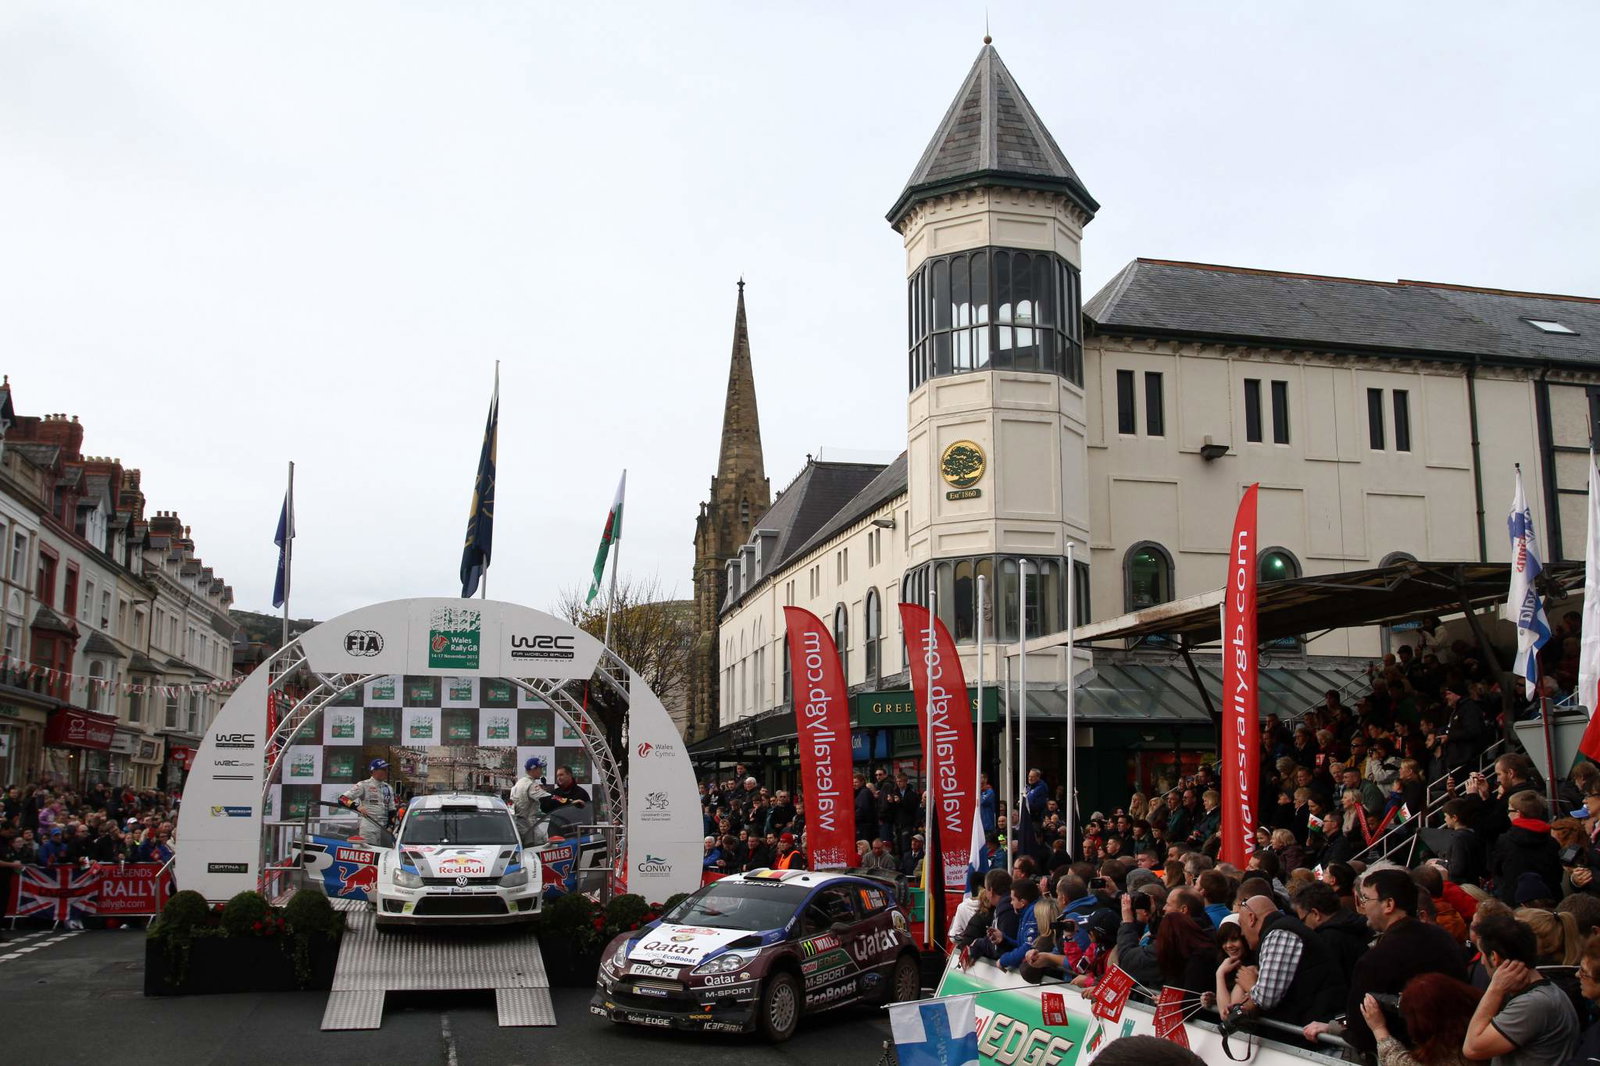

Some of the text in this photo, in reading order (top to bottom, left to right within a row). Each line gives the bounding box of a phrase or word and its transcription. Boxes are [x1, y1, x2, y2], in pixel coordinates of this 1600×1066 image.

[511, 634, 575, 649] WRC
[1232, 530, 1257, 855] walesrallygb.com
[872, 702, 918, 714] GREE
[216, 733, 255, 742] WRC
[340, 849, 371, 863] WALES
[543, 848, 571, 862] WALES
[439, 866, 485, 874] Red Bull
[638, 863, 673, 872] CONWY
[103, 881, 157, 897] RALLY
[643, 941, 699, 955] Qatar
[803, 940, 815, 957] 11
[853, 926, 899, 961] Qatar
[634, 965, 654, 975] PX12
[805, 966, 846, 988] M-SPORT
[704, 975, 735, 986] Qatar
[705, 987, 752, 998] M-SPORT
[645, 1017, 670, 1026] EDGE
